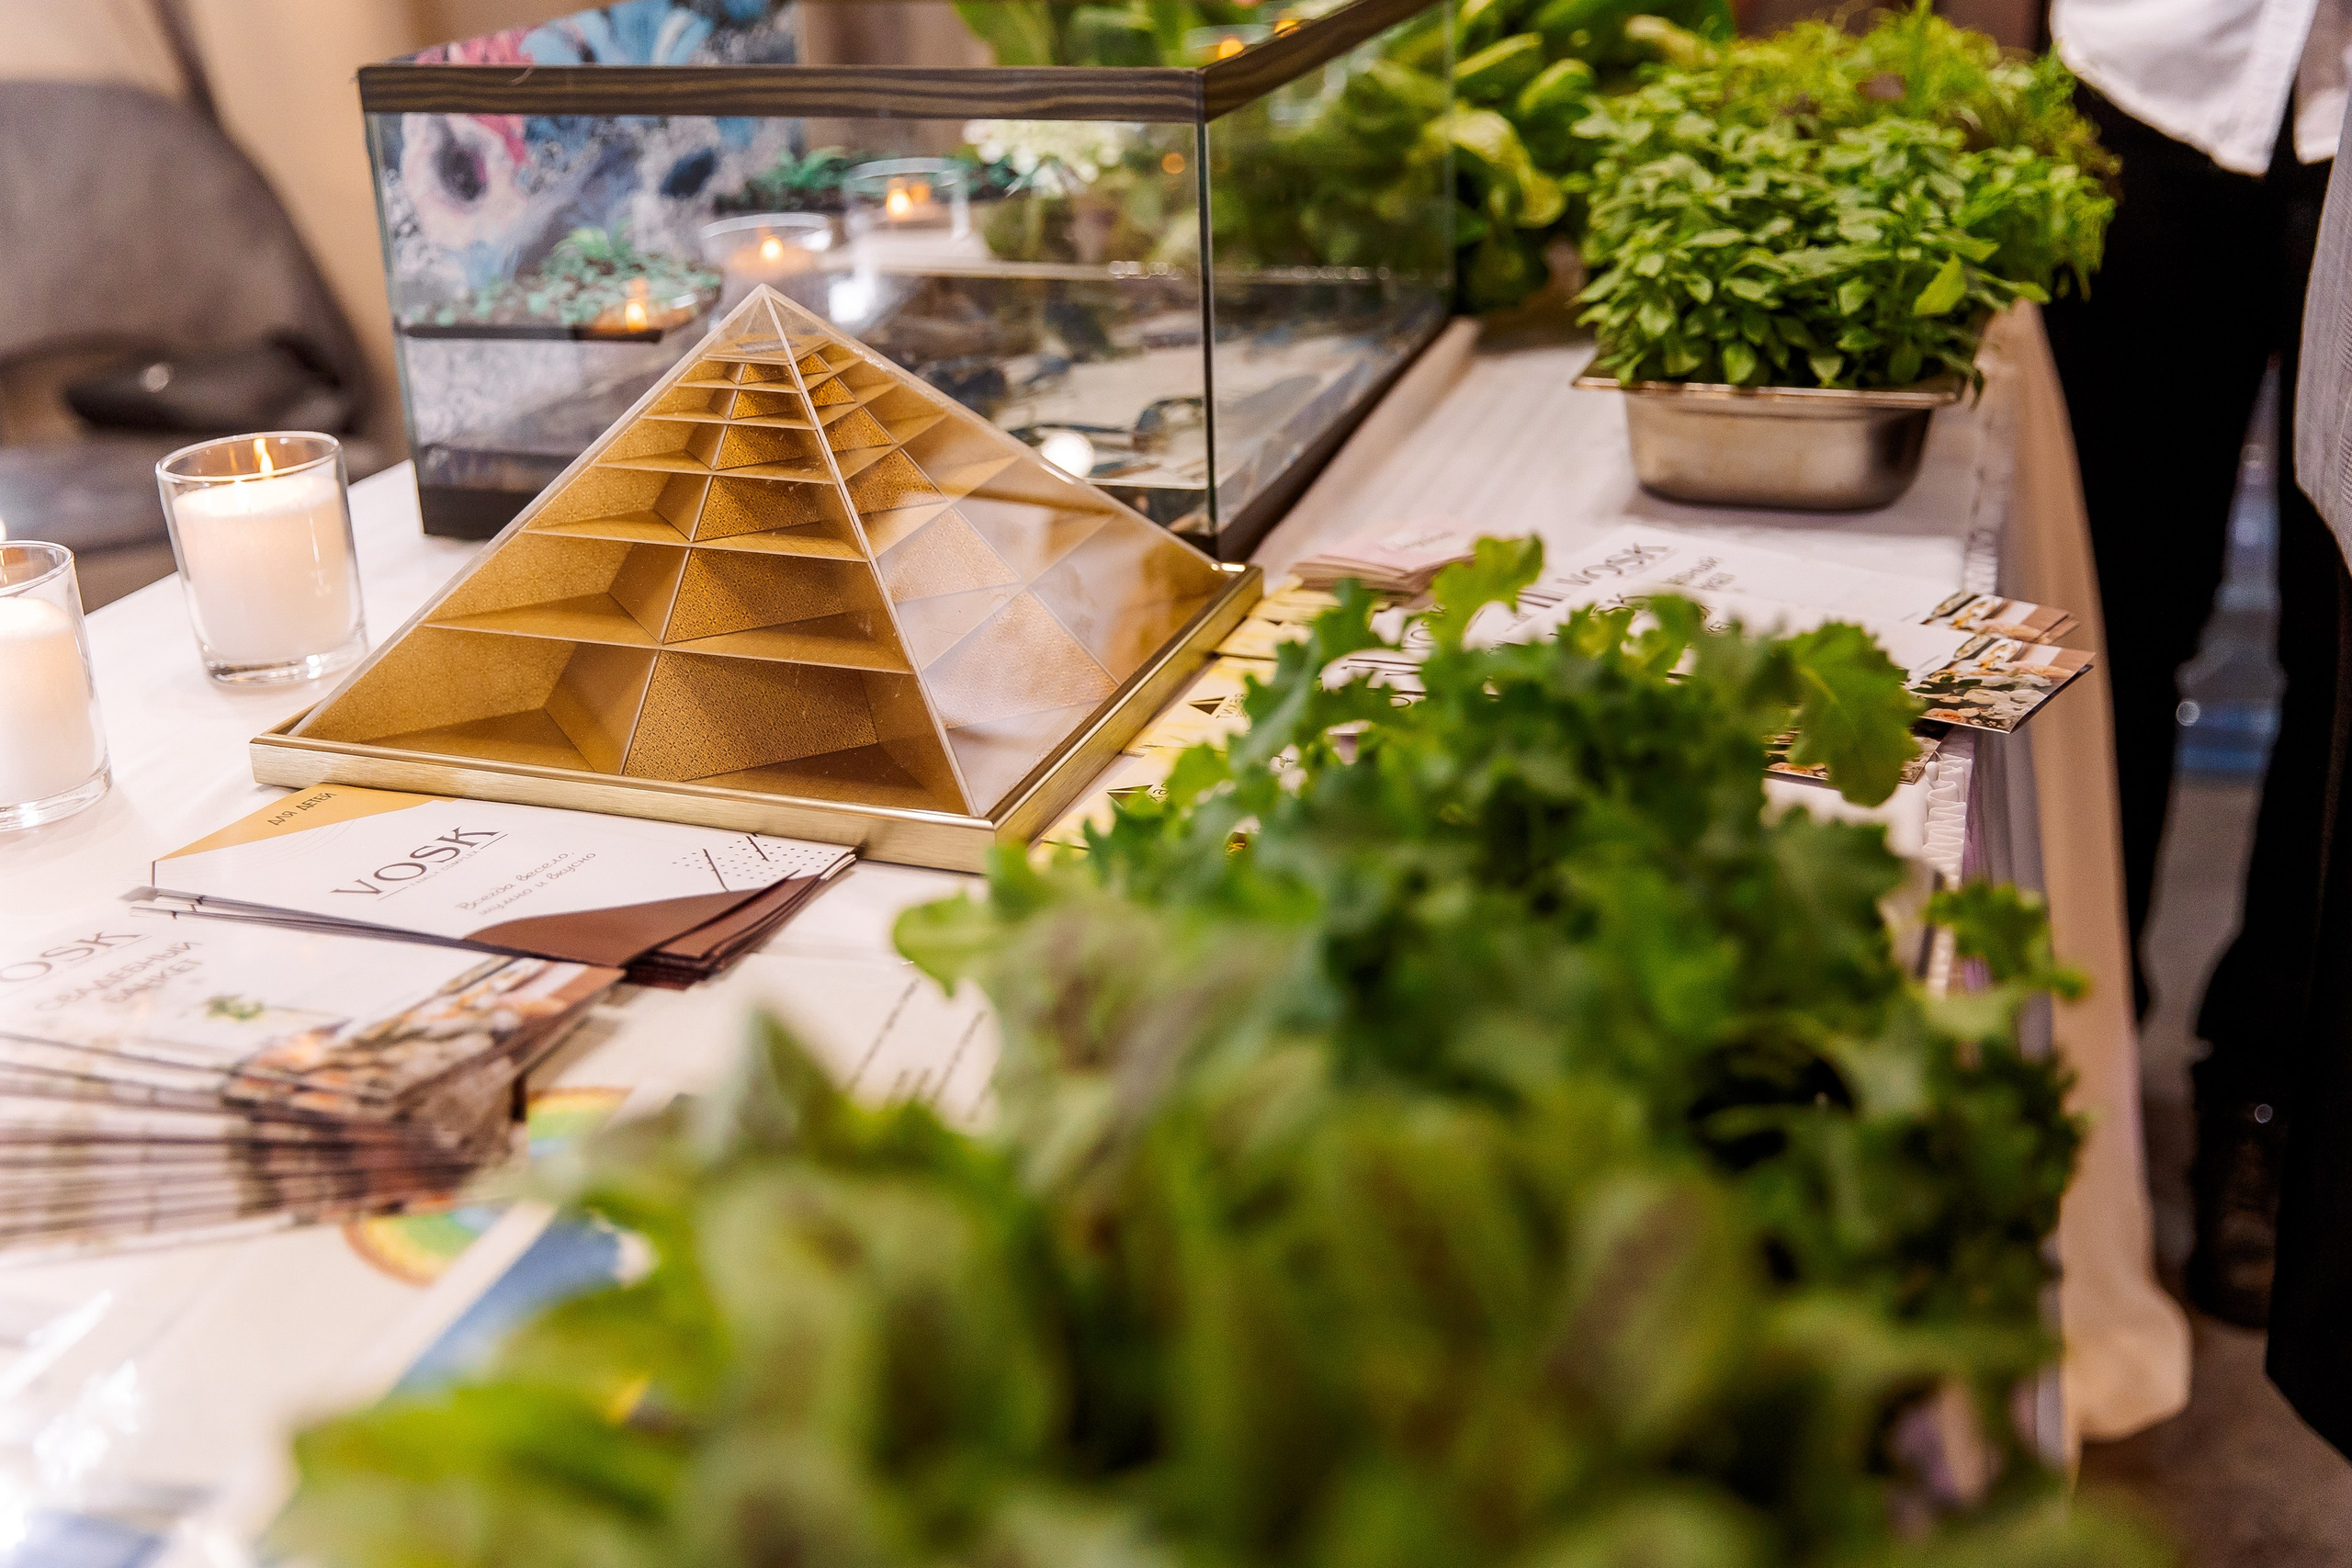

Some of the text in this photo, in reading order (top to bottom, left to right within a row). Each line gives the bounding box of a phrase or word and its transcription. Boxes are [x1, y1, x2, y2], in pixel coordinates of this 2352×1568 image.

[1555, 542, 1669, 586] VOSK
[267, 792, 337, 826] ДЛЯ ДЕТЕЙ
[330, 826, 503, 895] VOSK
[546, 852, 596, 880] вкусно
[456, 883, 516, 911] Всегда
[0, 931, 143, 983] OSK
